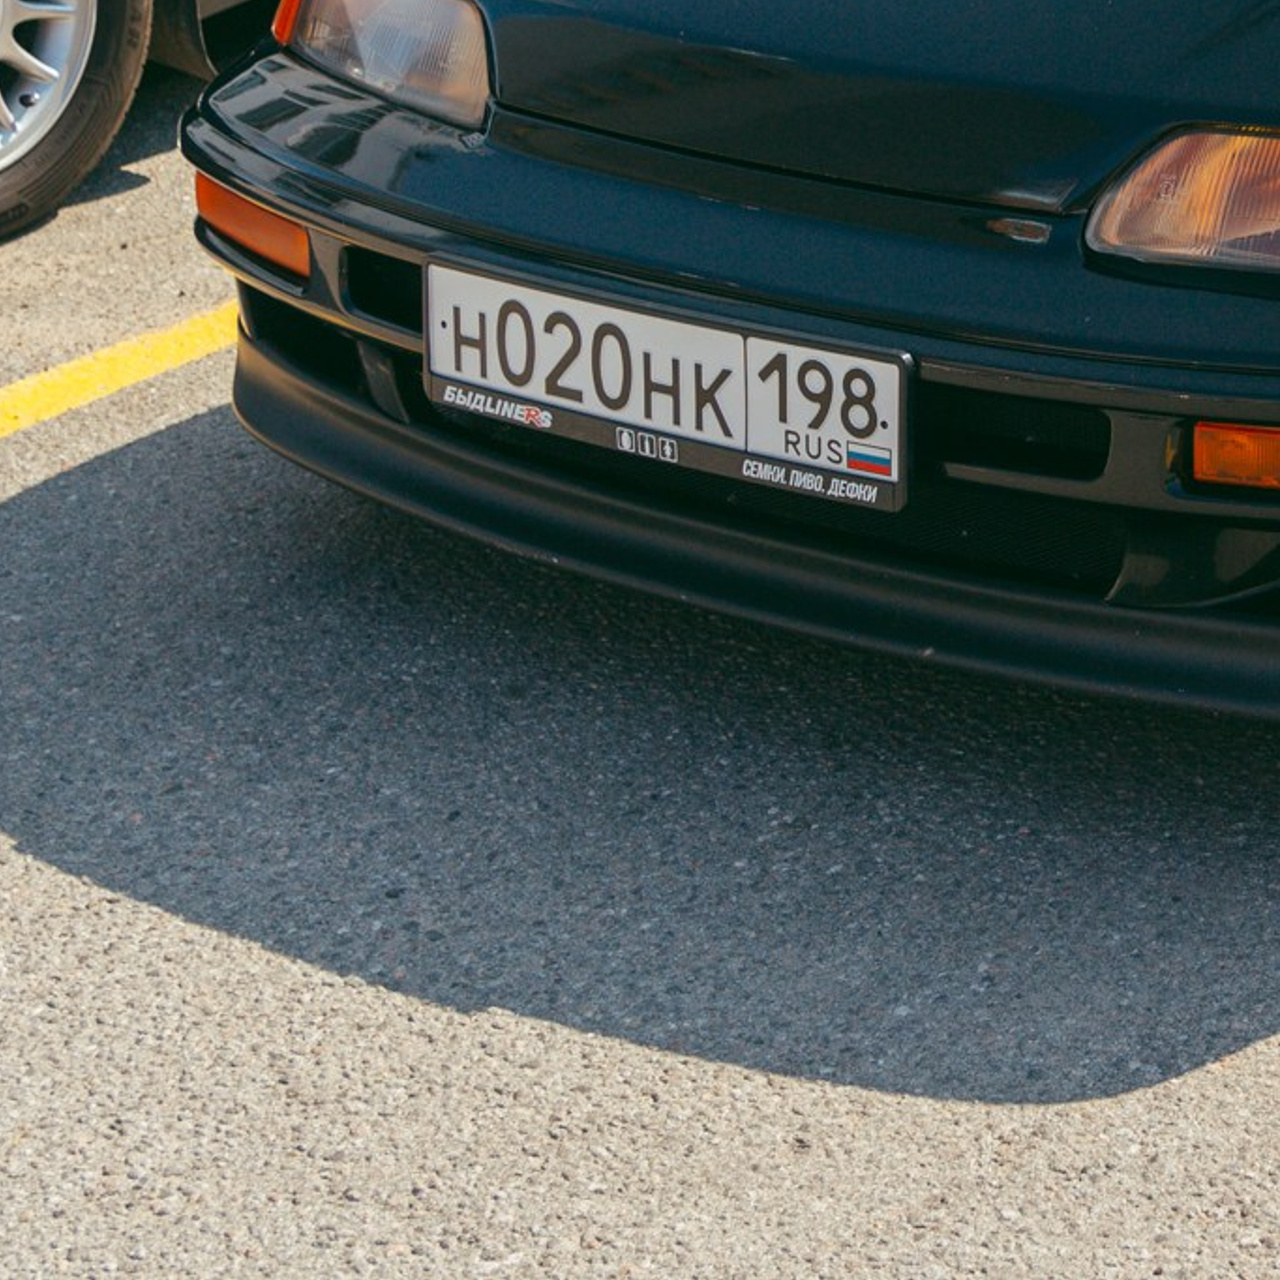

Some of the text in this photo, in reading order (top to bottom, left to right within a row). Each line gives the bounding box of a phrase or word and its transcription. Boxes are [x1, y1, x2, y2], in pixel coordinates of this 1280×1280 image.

[758, 353, 878, 439] 198
[785, 430, 843, 465] RUS
[827, 478, 878, 504] ДЕФКИ
